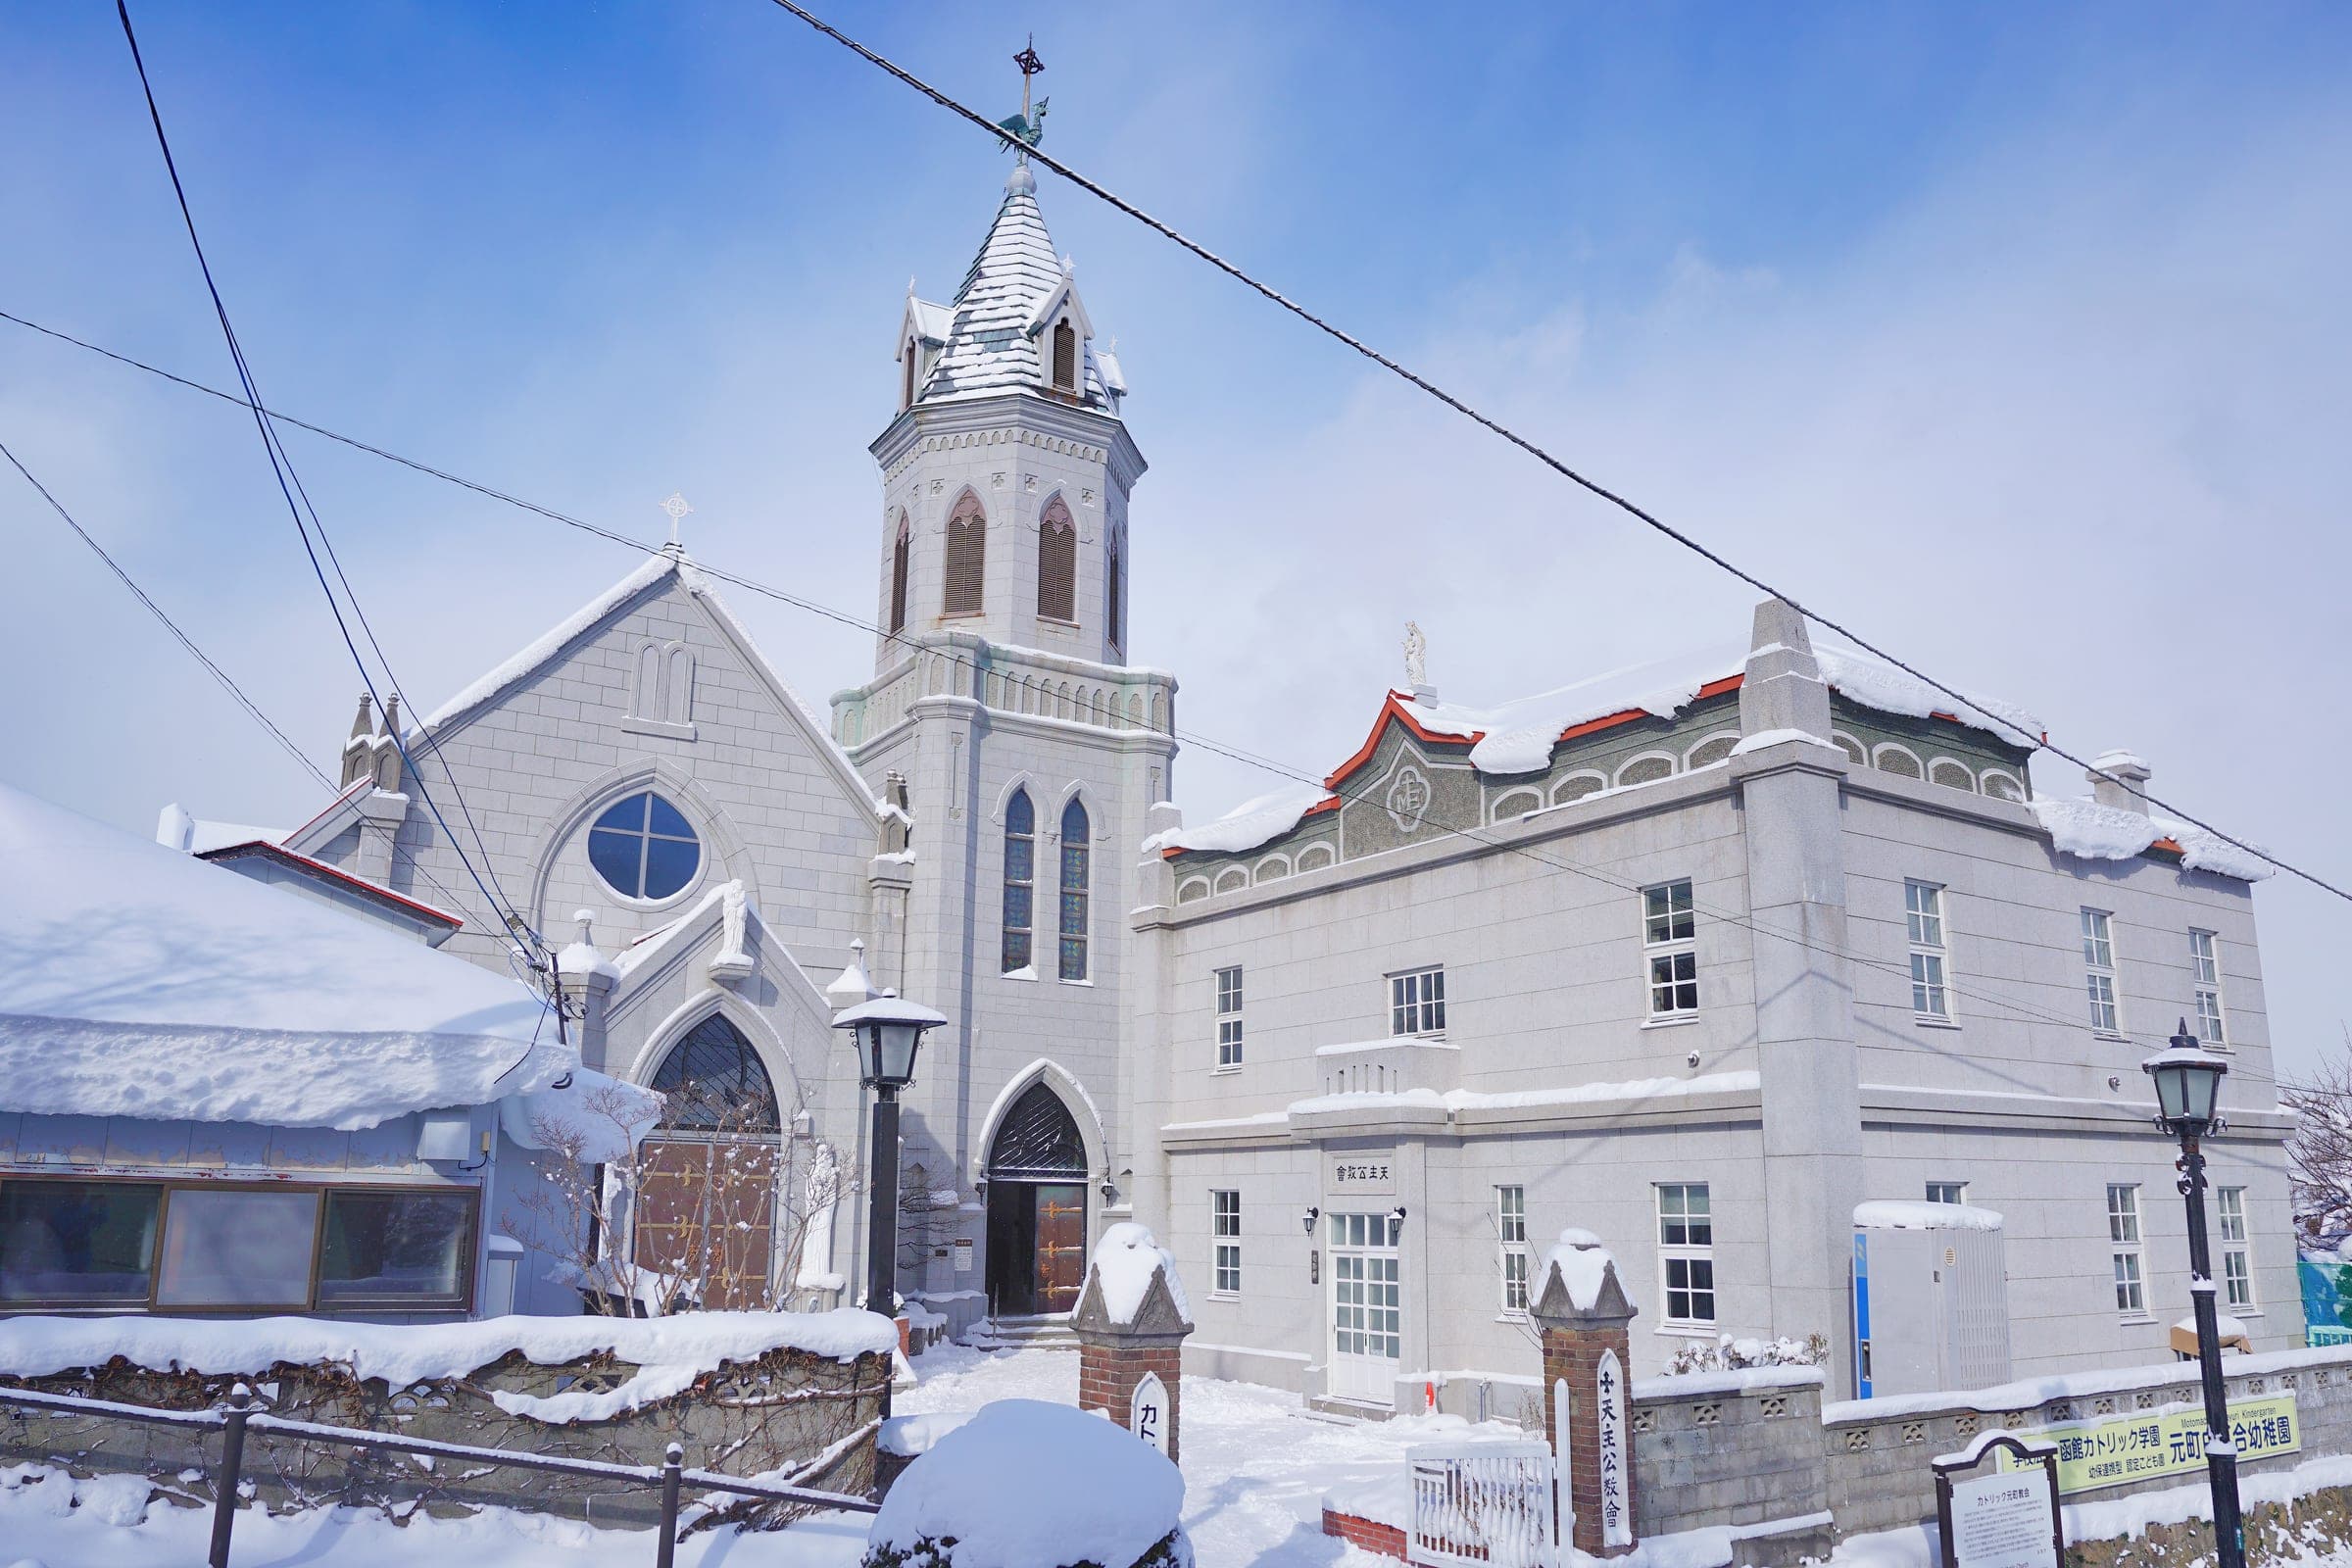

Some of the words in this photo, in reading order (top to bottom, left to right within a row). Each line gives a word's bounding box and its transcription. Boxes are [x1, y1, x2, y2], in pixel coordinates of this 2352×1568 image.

[1141, 1404, 1157, 1447] カト
[2180, 1416, 2207, 1429] Motomac
[2241, 1406, 2277, 1420] Kindergarten
[2059, 1425, 2161, 1462] 函館カトリック学園
[2169, 1416, 2291, 1464] 元町合幼稚園
[2126, 1452, 2165, 1473] 認定こども園
[1977, 1487, 2030, 1506] カトリック元町教会
